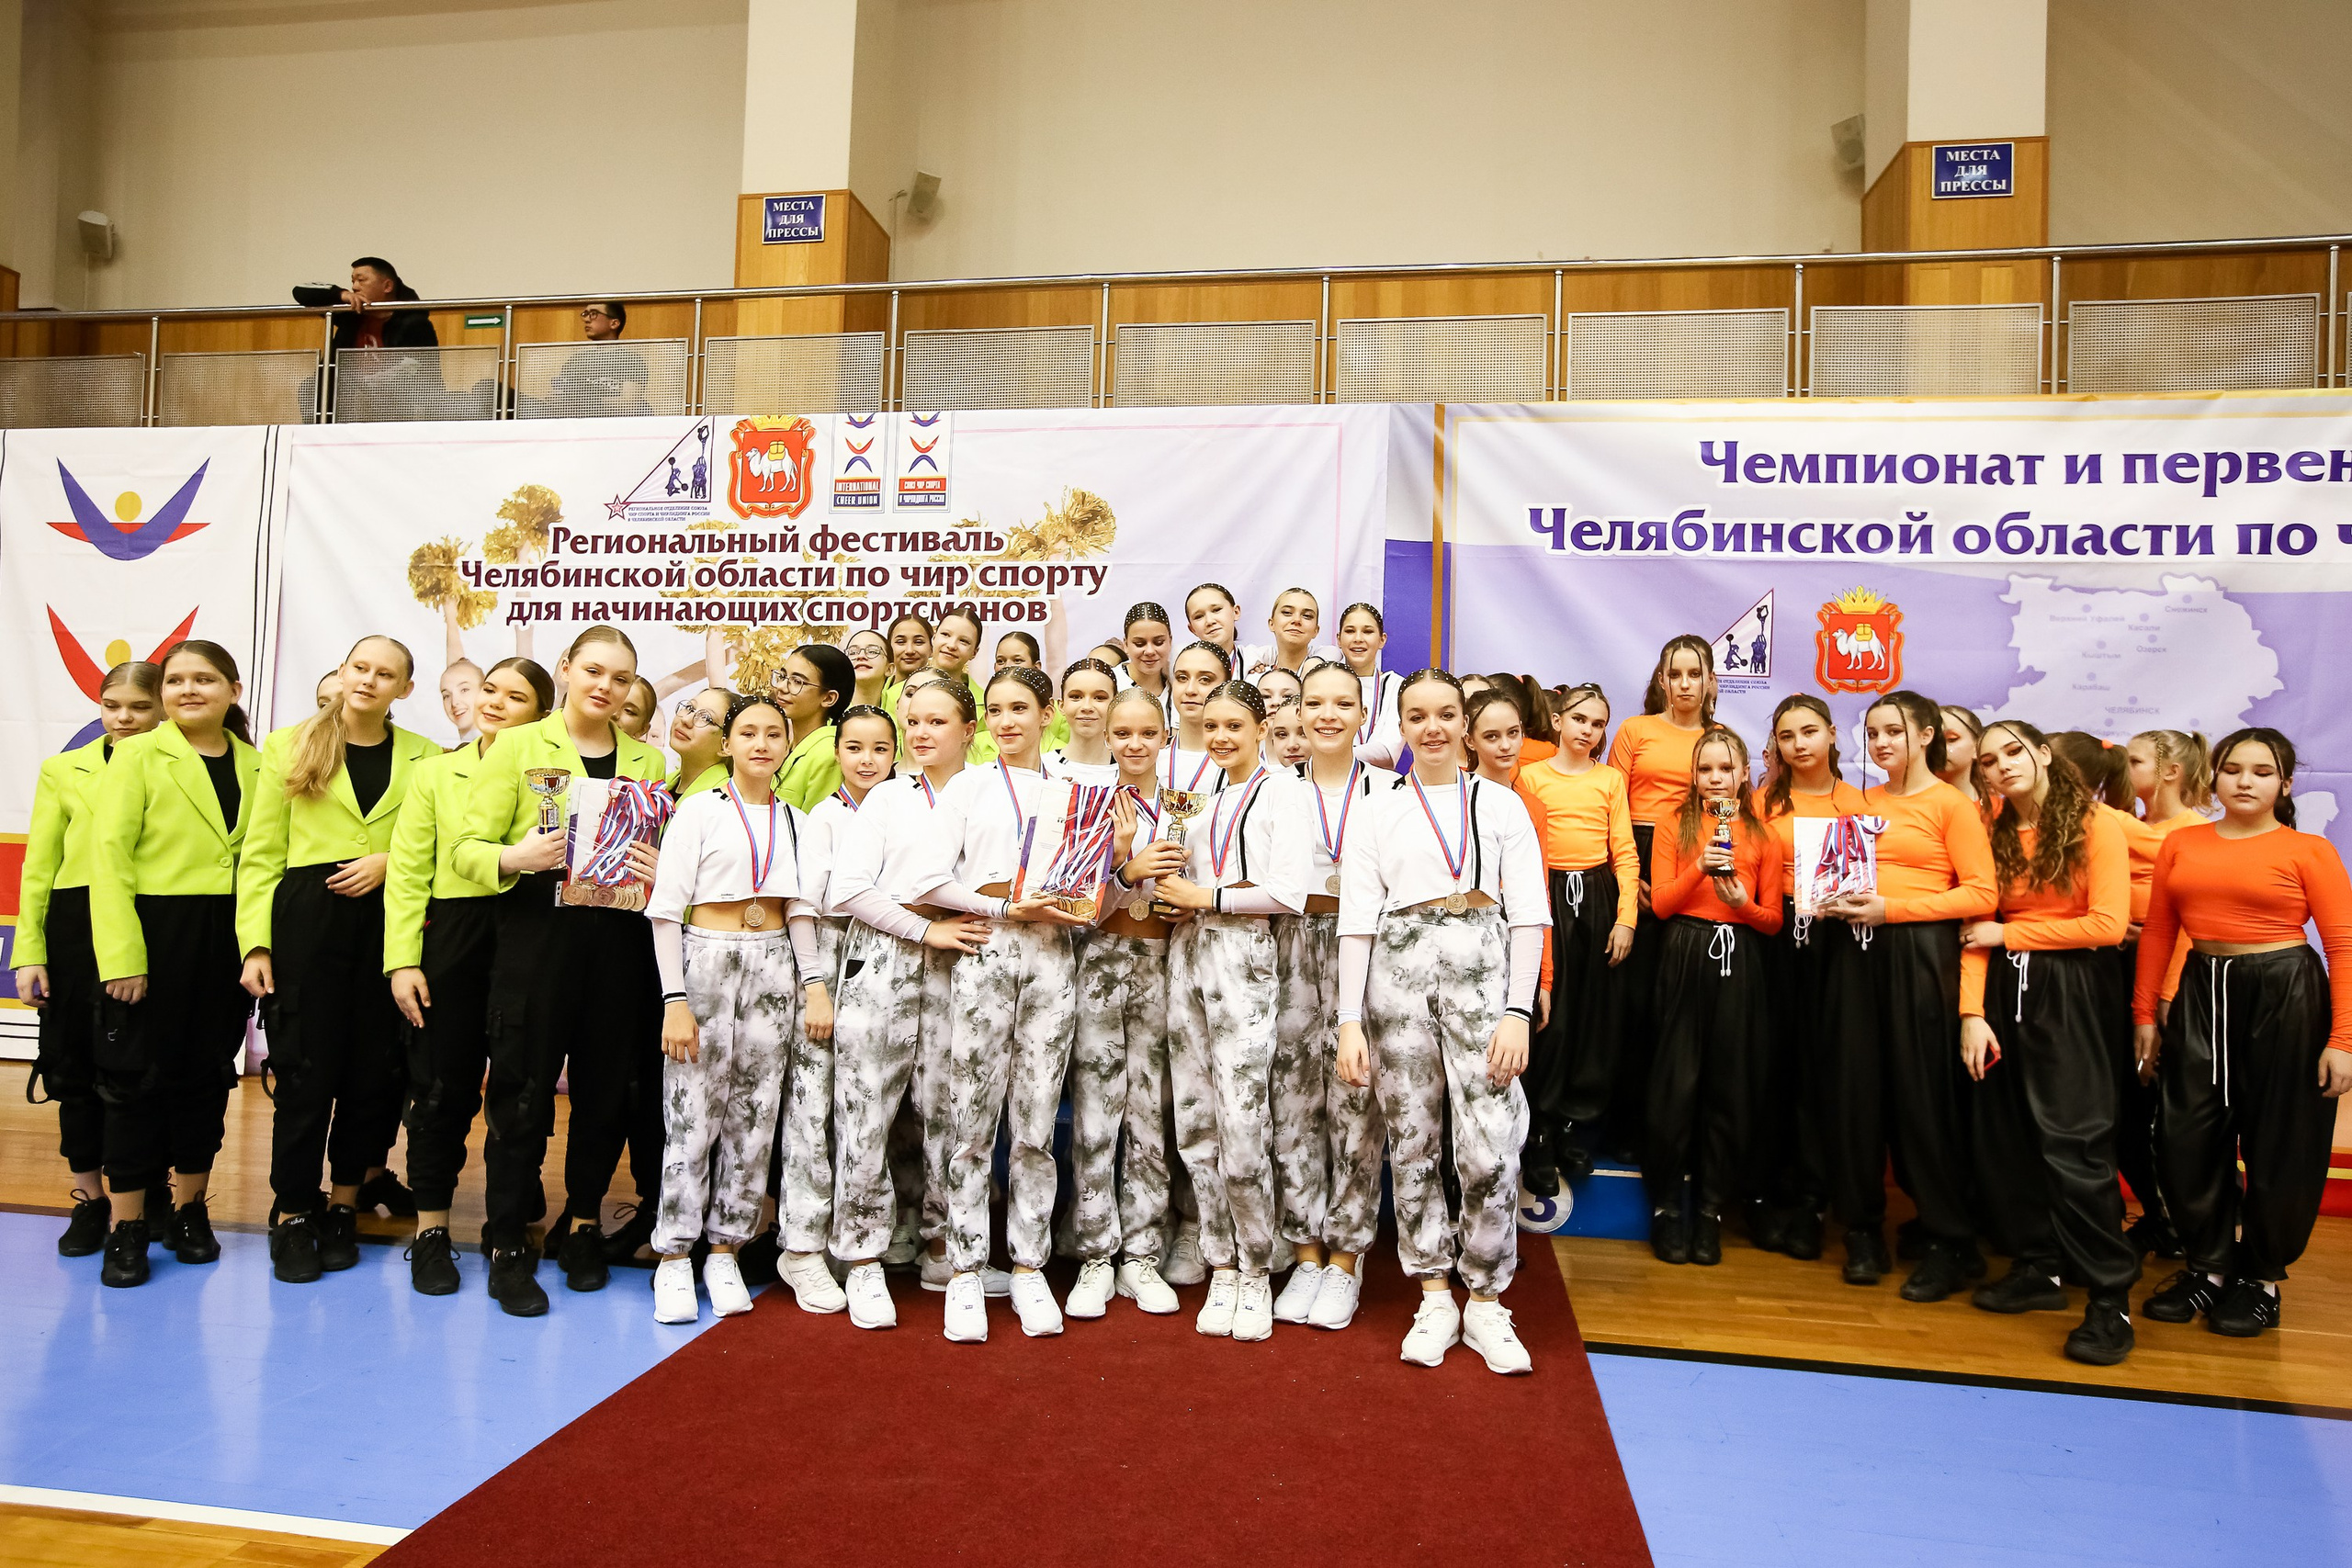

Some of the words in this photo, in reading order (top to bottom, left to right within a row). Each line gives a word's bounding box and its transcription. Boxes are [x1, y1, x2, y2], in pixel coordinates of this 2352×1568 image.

[1946, 150, 2001, 162] МЕСТА
[1954, 164, 1987, 178] ДЛЯ
[1940, 179, 2007, 192] ПРЕССЫ
[773, 200, 815, 212] МЕСТА
[779, 213, 805, 226] ДЛЯ
[767, 226, 820, 239] ПРЕССЫ
[1699, 440, 2045, 485] Чемпионат
[2064, 454, 2103, 484] и
[835, 481, 880, 491] INTERNATIONAL
[836, 495, 855, 505] CHEER
[857, 495, 878, 505] UNION
[1528, 507, 1934, 555] Челябинской
[1952, 511, 2215, 556] области
[2236, 522, 2317, 556] по
[551, 525, 799, 555] Региональный
[809, 524, 1004, 560] фестиваль
[461, 559, 685, 588] Челябинской
[695, 558, 835, 588] области
[845, 566, 890, 588] по
[900, 565, 967, 595] чир
[979, 565, 1108, 595] спорту
[506, 601, 562, 626] для
[571, 600, 798, 627] начинающих
